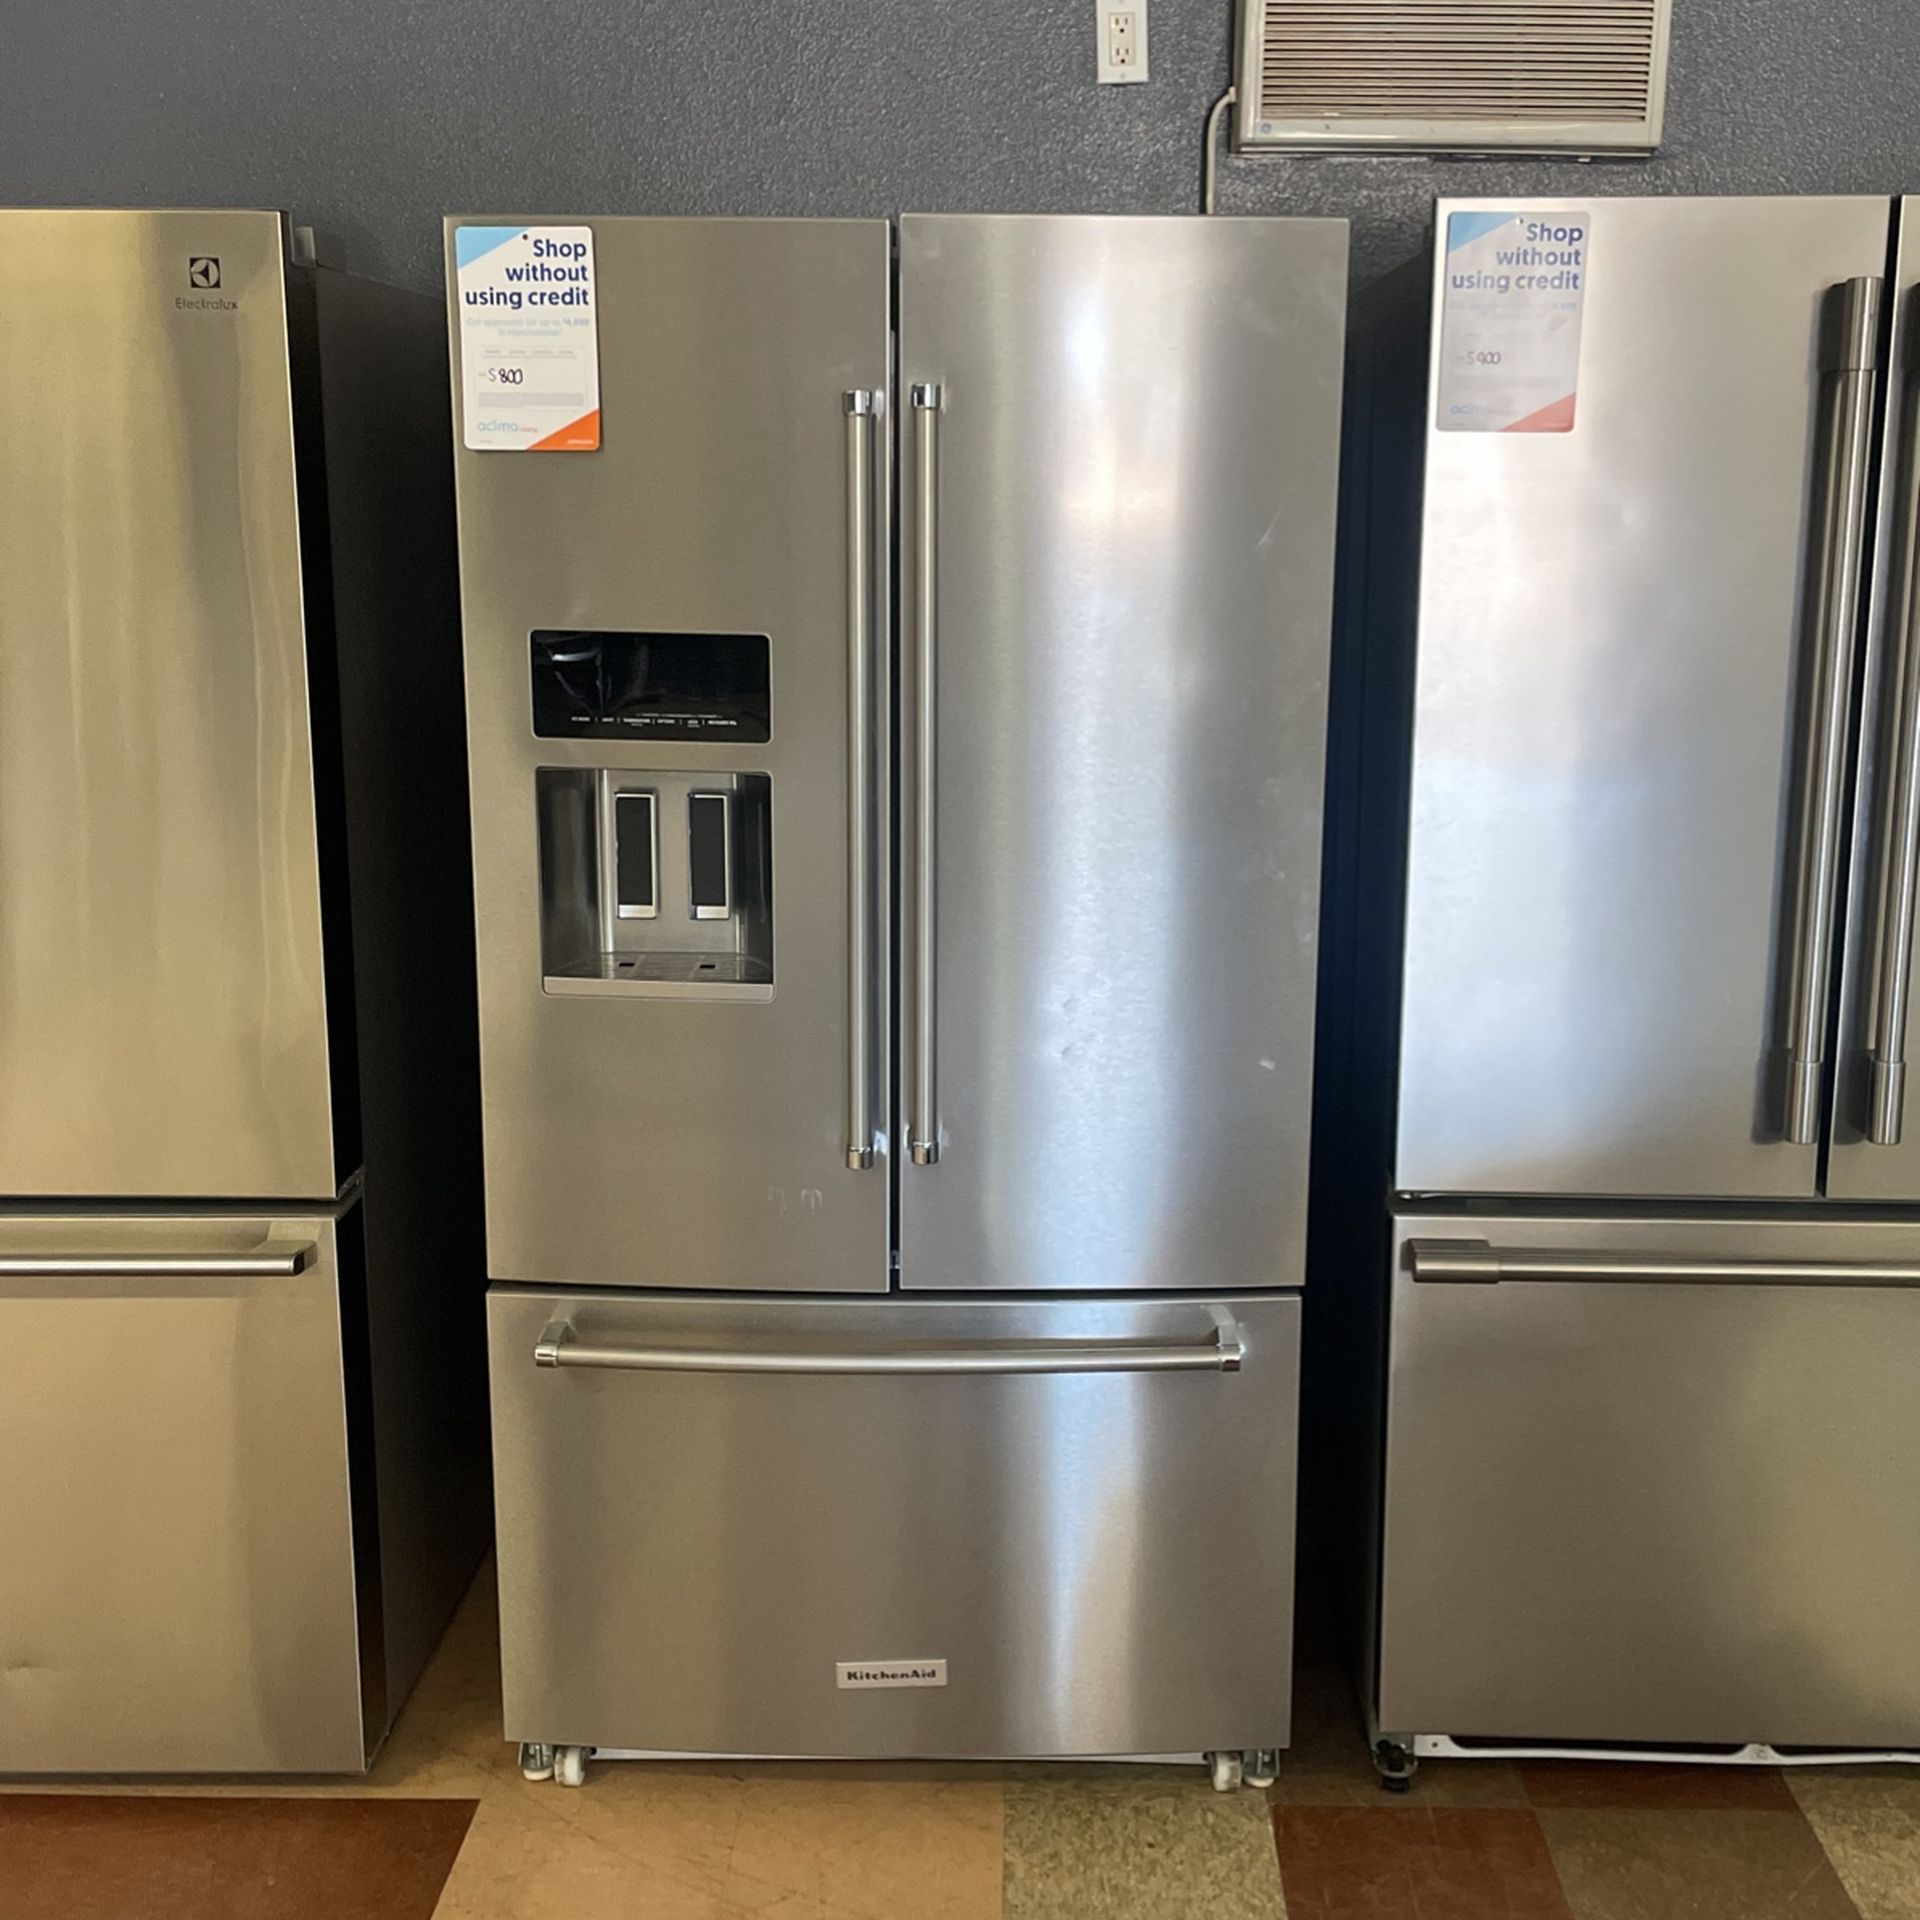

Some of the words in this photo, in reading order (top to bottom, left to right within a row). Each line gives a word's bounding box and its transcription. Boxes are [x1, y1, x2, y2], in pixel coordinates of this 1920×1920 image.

[1525, 223, 1583, 245] Shop
[532, 239, 587, 261] Shop
[1496, 246, 1582, 266] without
[505, 263, 588, 282] without
[1451, 270, 1510, 293] using
[1515, 270, 1580, 290] credit
[174, 297, 238, 310] Electrolux
[465, 286, 523, 310] using
[527, 286, 590, 306] credit
[846, 1669, 937, 1681] KitchenAid
